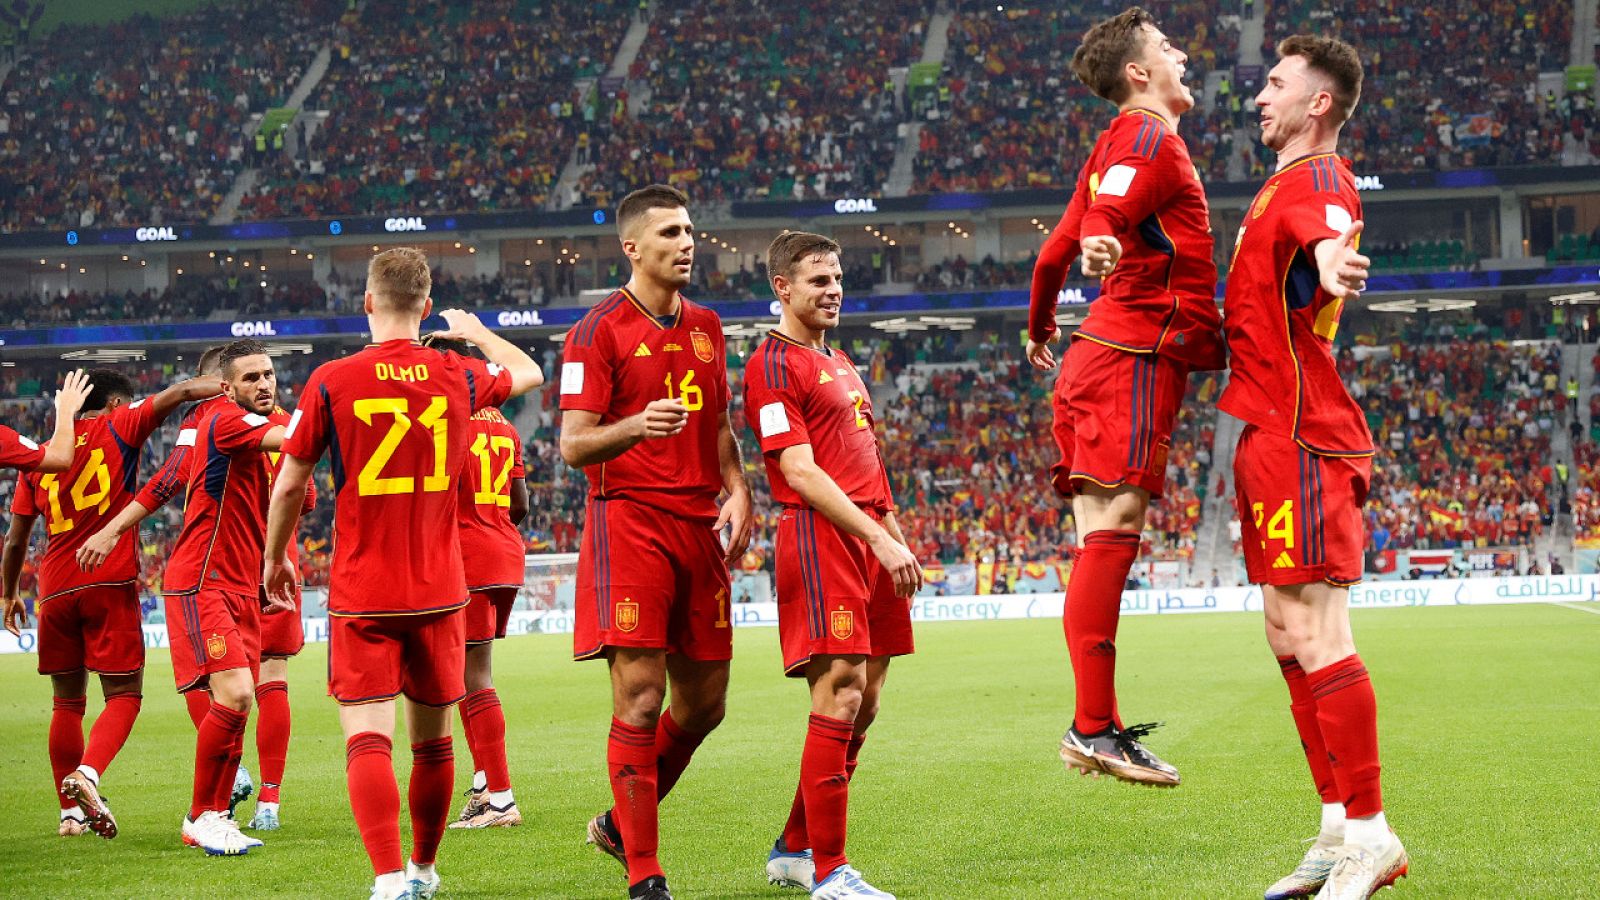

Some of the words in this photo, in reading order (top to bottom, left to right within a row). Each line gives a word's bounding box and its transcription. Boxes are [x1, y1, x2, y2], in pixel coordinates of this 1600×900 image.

[1355, 175, 1384, 190] OAL
[835, 198, 878, 213] GOAL
[136, 226, 178, 241] GOAL
[385, 217, 427, 231] GOAL
[1057, 289, 1087, 304] OAL
[498, 310, 543, 326] GOAL
[231, 321, 277, 337] GOAL
[375, 363, 429, 382] OLMO
[664, 369, 704, 411] 16
[847, 389, 868, 428] 2
[353, 396, 450, 496] 21
[470, 433, 515, 508] 12
[40, 447, 111, 535] 14
[1350, 586, 1432, 606] Energy
[913, 600, 1003, 620] rEnergy
